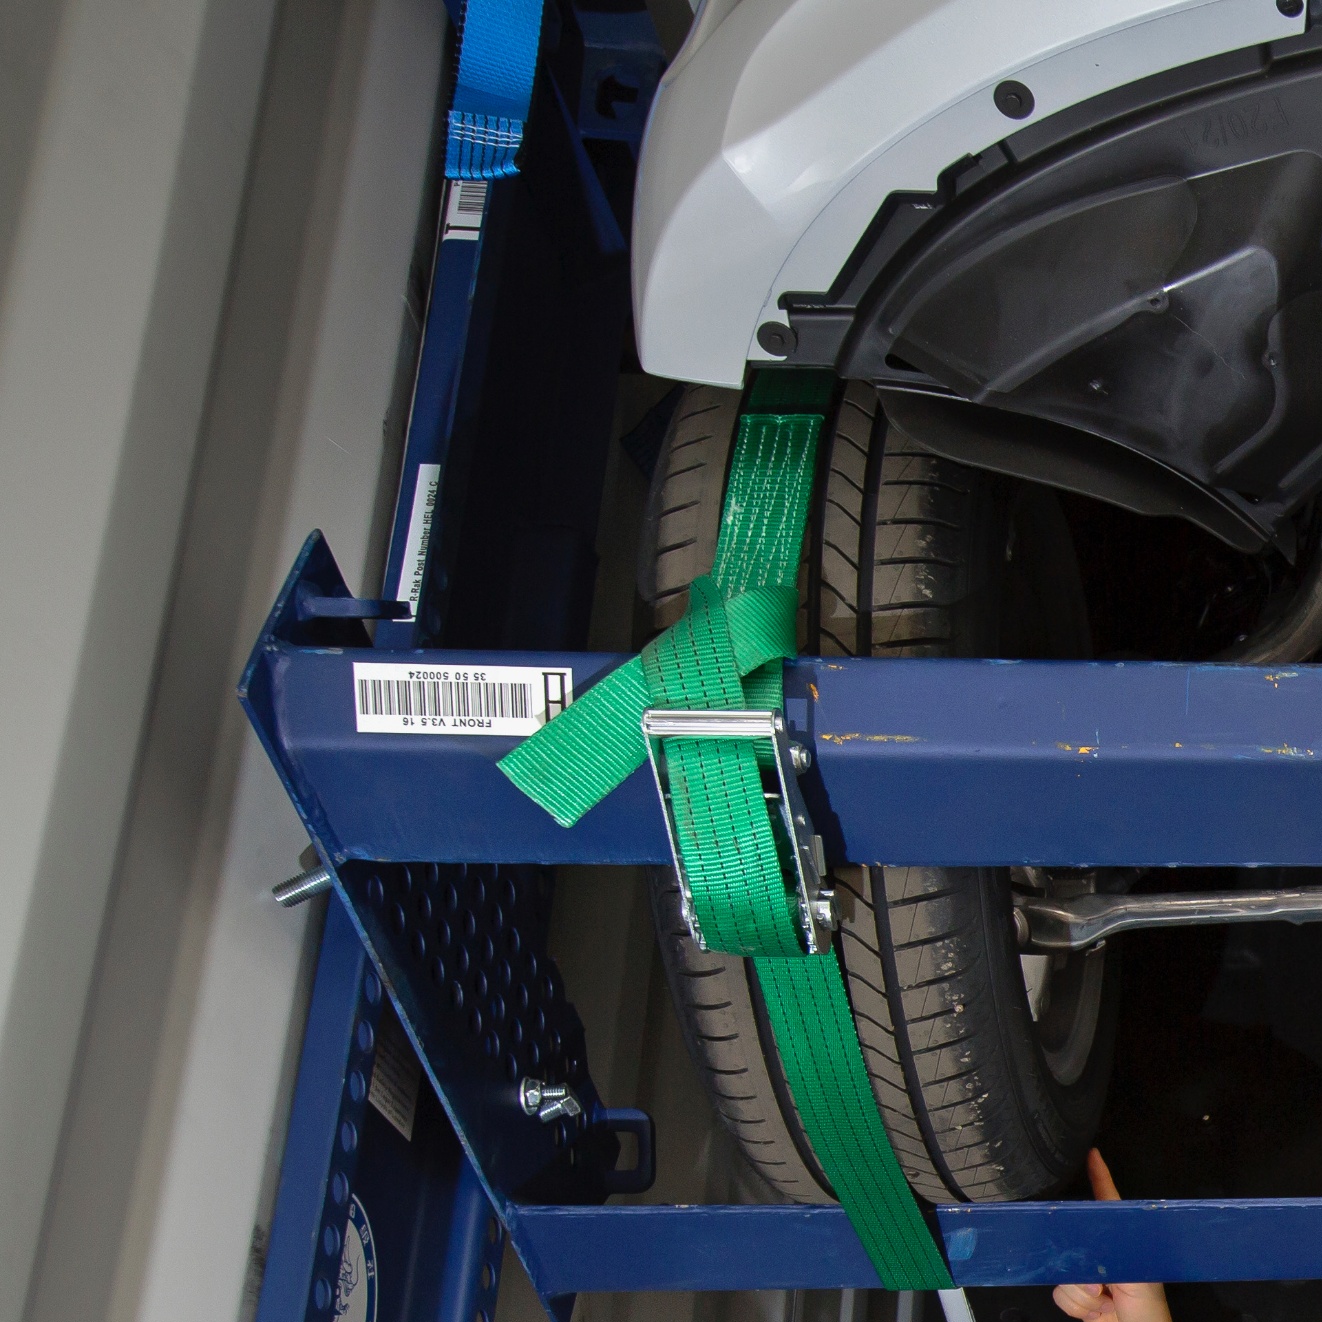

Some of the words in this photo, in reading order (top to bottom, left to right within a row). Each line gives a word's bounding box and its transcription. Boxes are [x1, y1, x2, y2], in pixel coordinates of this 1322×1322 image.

[426, 489, 437, 507] 0024
[422, 509, 433, 525] HEL
[418, 528, 431, 557] Number
[413, 559, 425, 577] Post
[409, 579, 422, 602] R-Rak
[408, 671, 450, 681] 500024
[454, 672, 469, 682] 50
[473, 672, 487, 682] 35
[402, 717, 415, 727] 16
[421, 717, 446, 727] V3.5
[451, 718, 492, 728] FRONT
